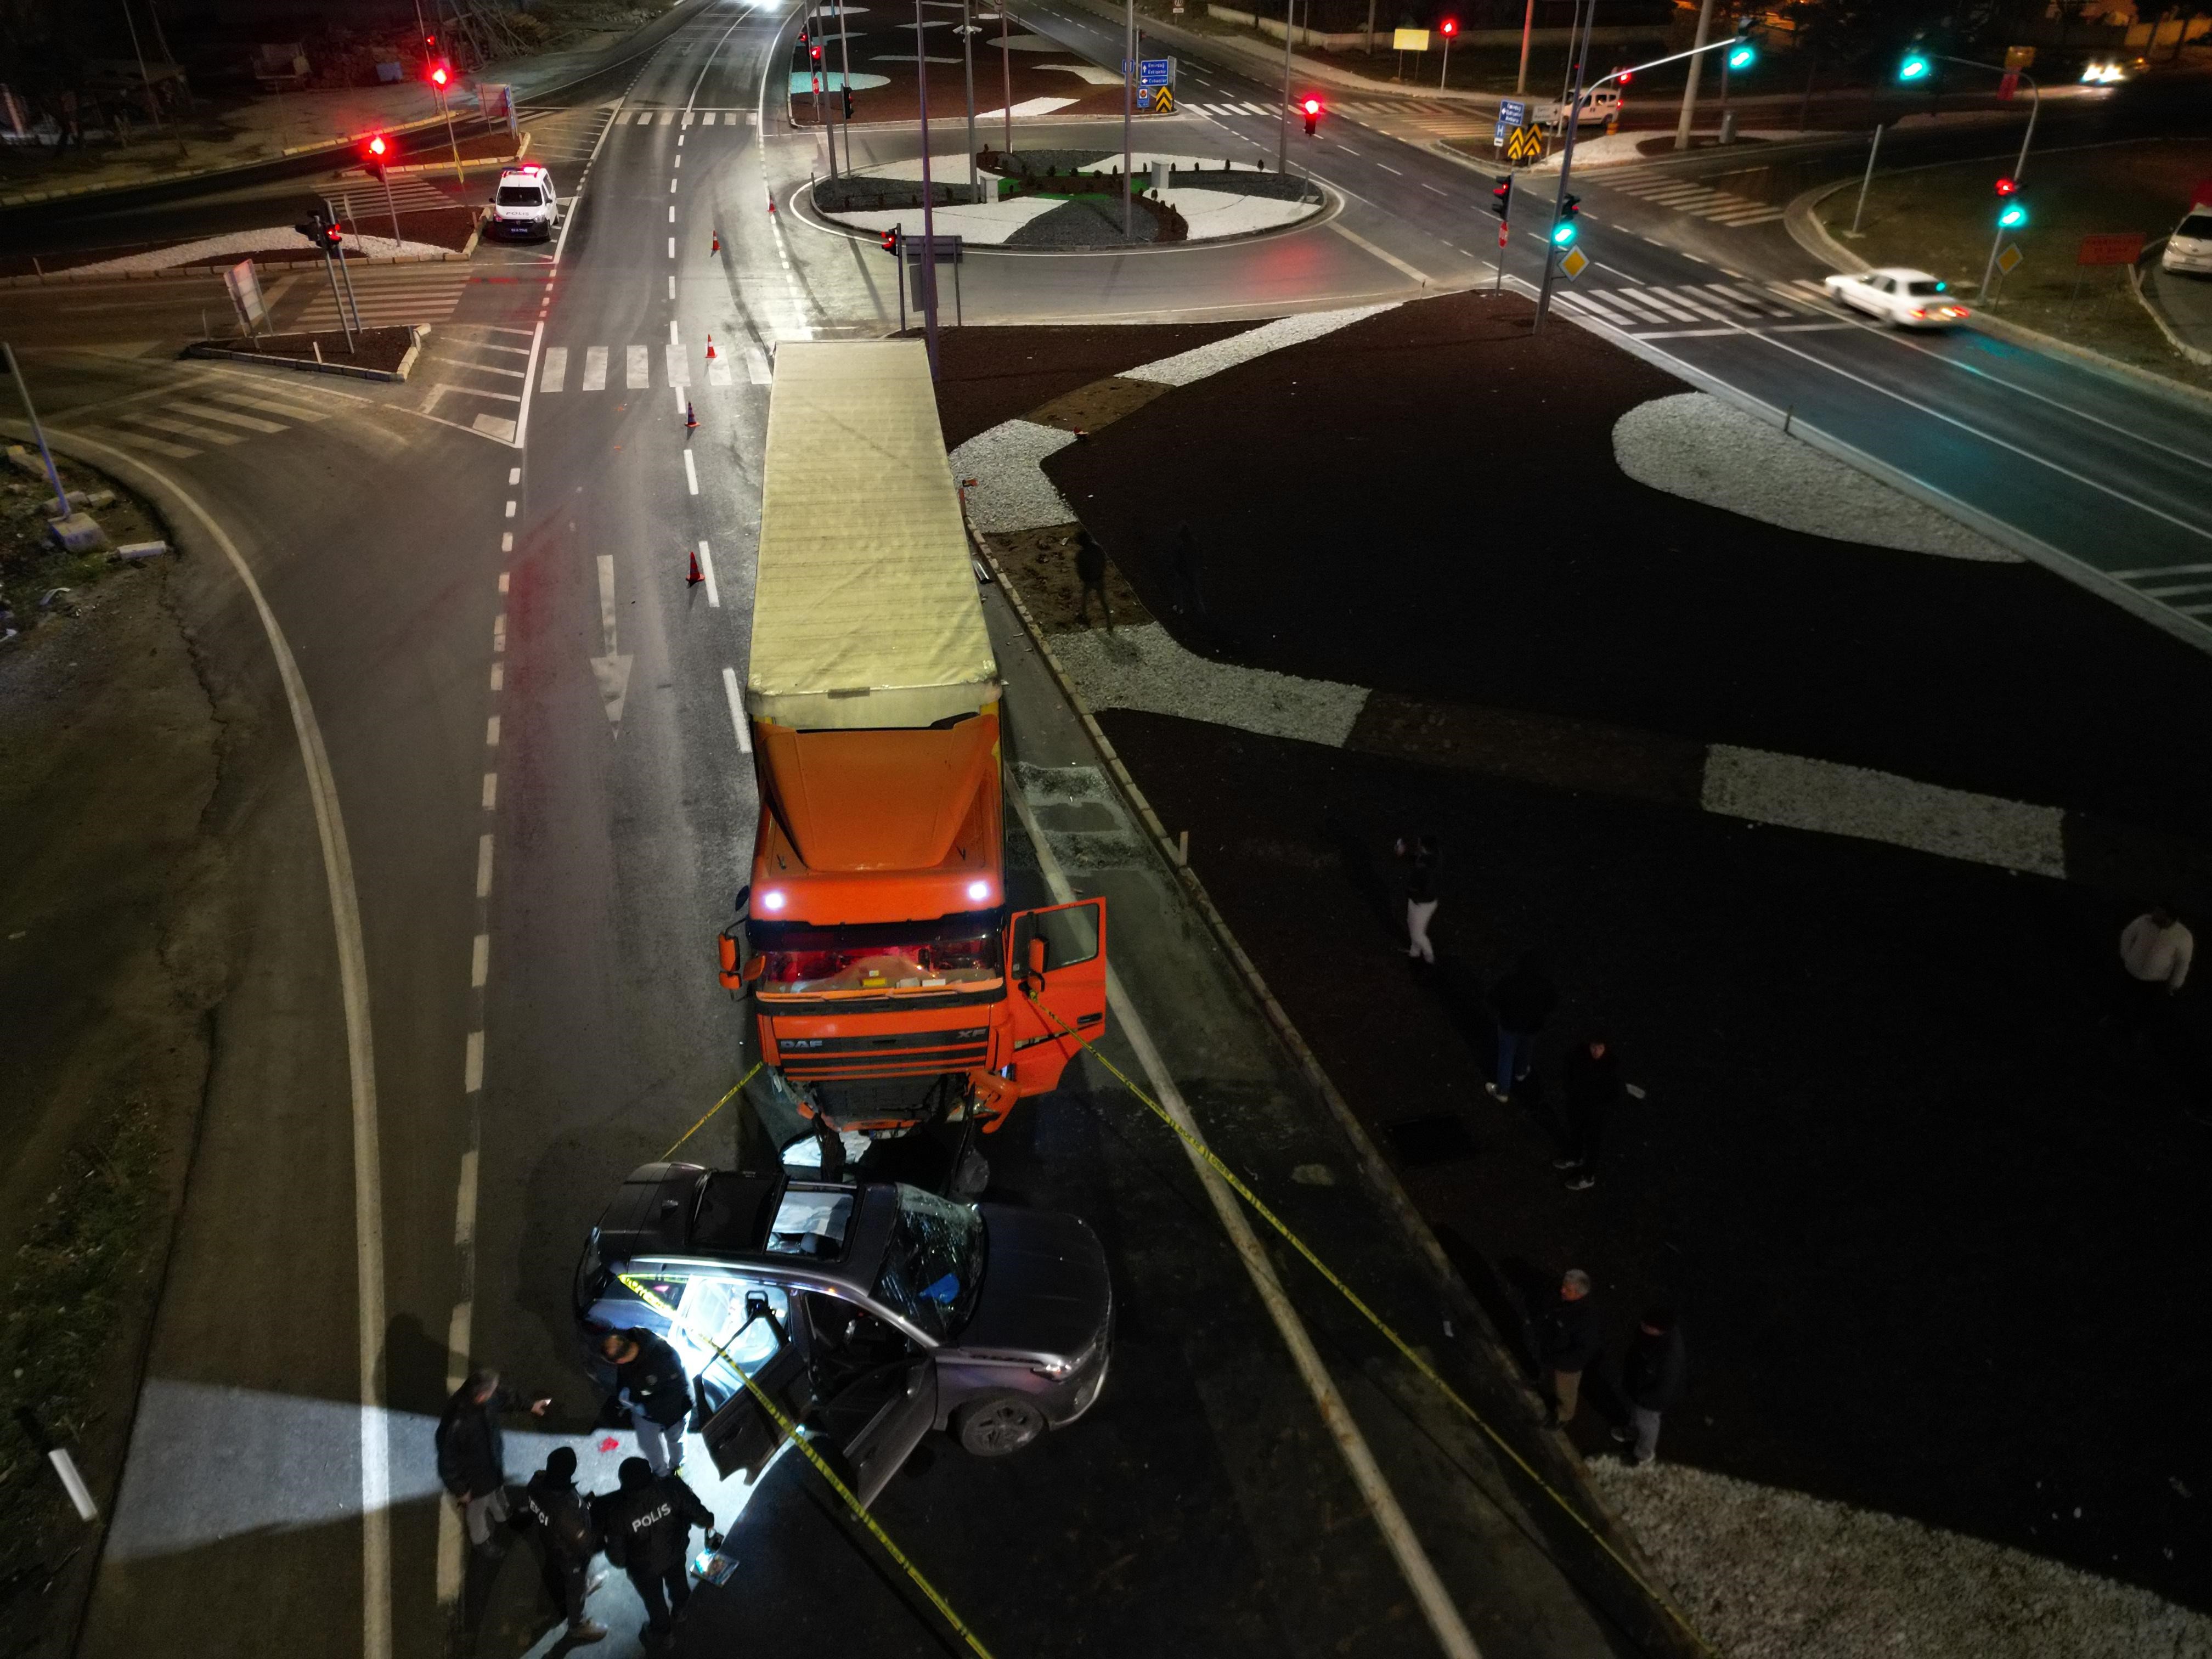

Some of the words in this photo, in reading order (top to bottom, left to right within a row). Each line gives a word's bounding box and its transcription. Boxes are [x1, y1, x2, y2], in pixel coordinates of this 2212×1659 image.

[1497, 125, 1504, 137] H
[956, 1029, 986, 1039] XF
[781, 1040, 823, 1048] DAF
